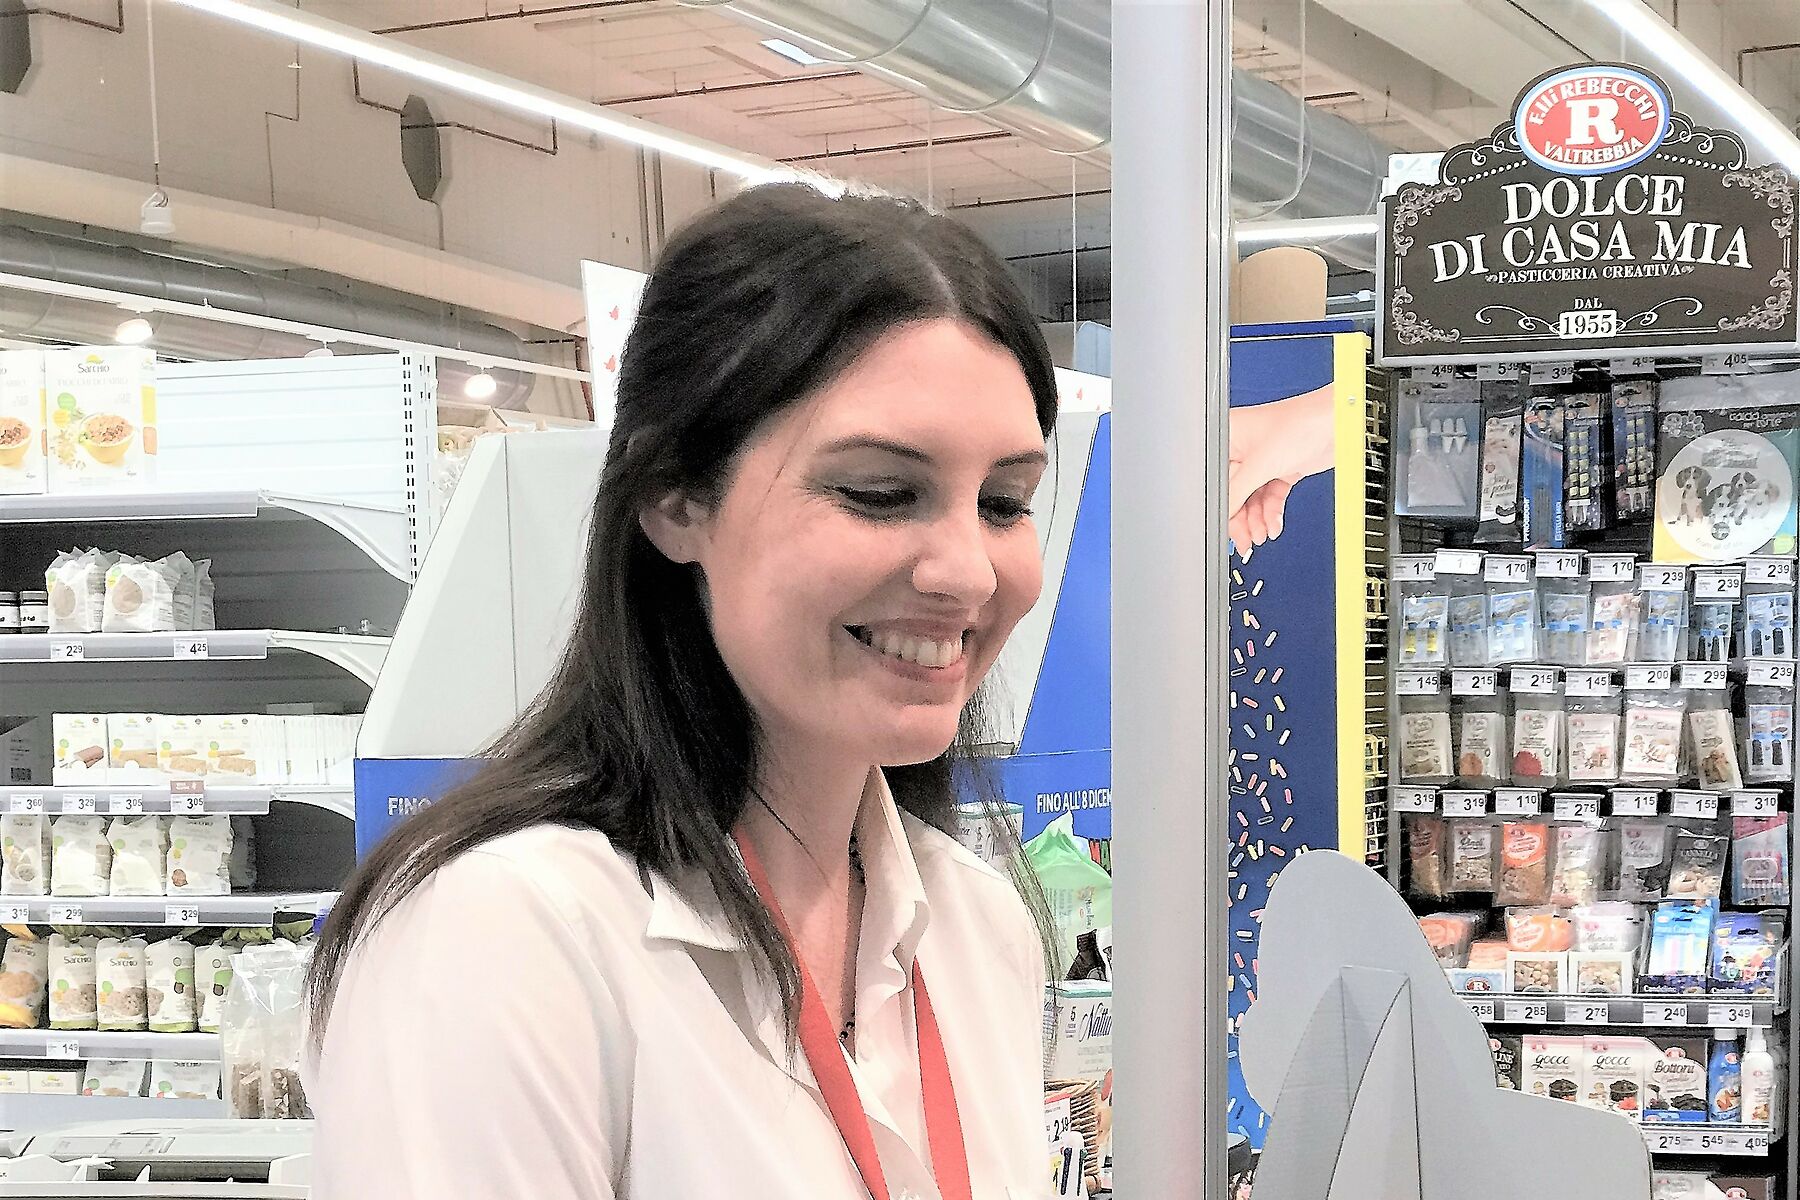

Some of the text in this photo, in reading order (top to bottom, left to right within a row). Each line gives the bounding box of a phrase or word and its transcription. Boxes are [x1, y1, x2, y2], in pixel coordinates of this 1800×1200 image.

[1528, 78, 1657, 125] F.lli REBECCHI
[1566, 98, 1624, 145] R
[1544, 137, 1644, 164] VALTREBBIA
[1501, 174, 1685, 225] DOLCE
[1428, 220, 1754, 283] DI CASA MIA
[1498, 263, 1682, 284] PASTICCERIA CREATIVA
[1574, 297, 1603, 310] DAL
[1562, 313, 1614, 336] 1955
[1036, 792, 1061, 814] FINO
